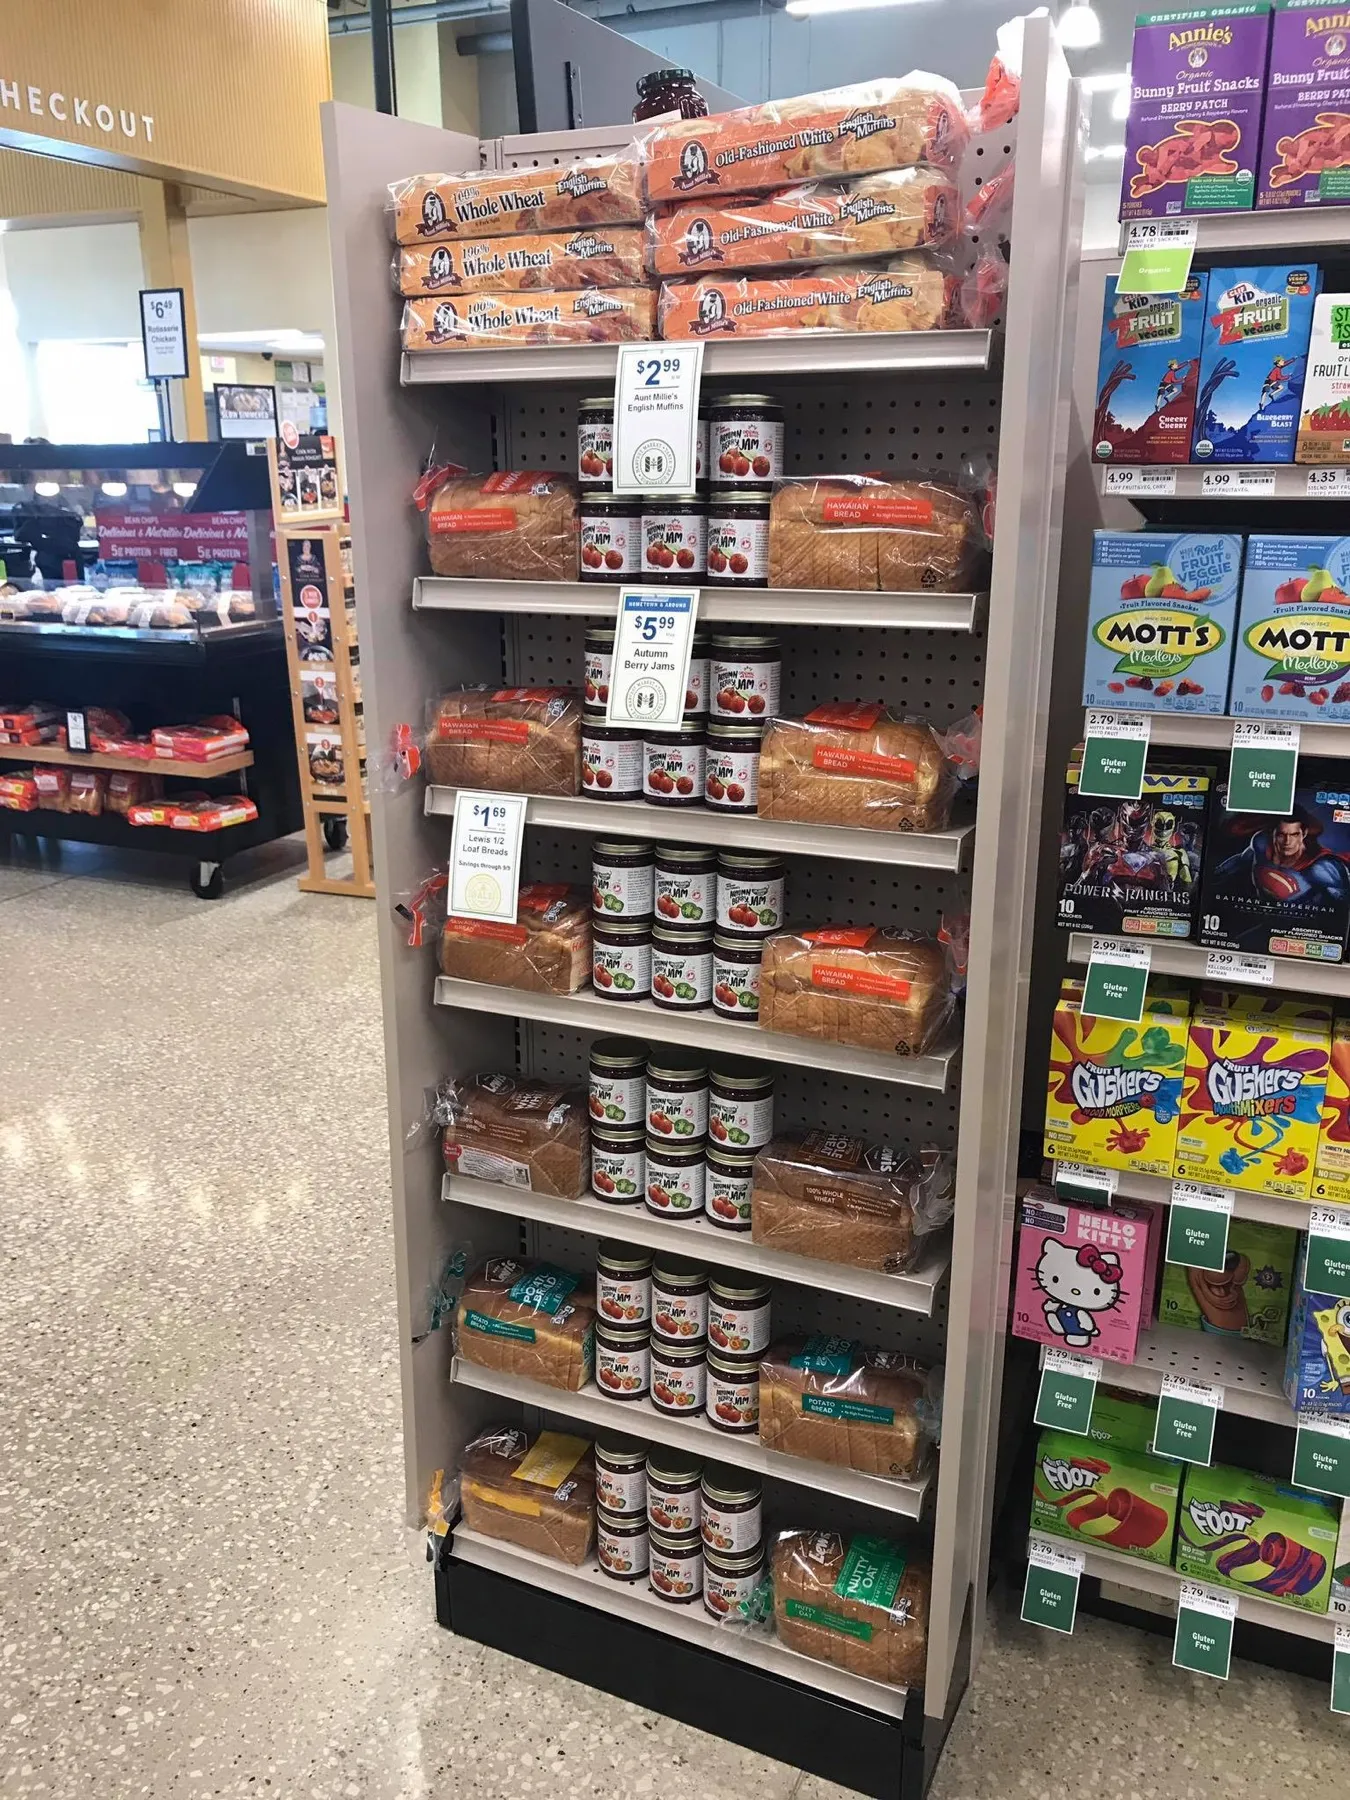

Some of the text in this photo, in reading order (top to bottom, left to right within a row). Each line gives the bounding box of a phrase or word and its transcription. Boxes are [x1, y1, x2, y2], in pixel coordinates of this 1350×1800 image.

[1150, 5, 1257, 22] CERTIFIED ORGANIC
[1168, 22, 1233, 51] Annie's
[1176, 70, 1214, 81] Organic
[1273, 67, 1350, 85] Bunny Fruit
[1134, 76, 1260, 99] Bunny Fruit Snacks
[1298, 91, 1330, 101] BERRY
[1161, 99, 1228, 113] BERRY PATCH
[838, 111, 896, 142] English Muffins
[715, 138, 796, 168] Old-Fashioned
[799, 129, 834, 147] White
[557, 173, 608, 199] English Muffins
[455, 190, 546, 224] Whole Wheat
[840, 198, 895, 224] English Muffins
[720, 213, 834, 245] Old-Fashioned White
[1130, 226, 1157, 238] 4.78
[565, 237, 614, 259] English Muffins
[463, 250, 553, 277] Whole Wheat
[1138, 266, 1171, 275] Organic
[857, 279, 912, 303] English Muffins
[733, 292, 850, 317] Old-Fashioned White
[468, 312, 513, 332] Whole
[1313, 364, 1341, 377] FRUIT
[653, 392, 678, 401] Millie's
[628, 402, 684, 412] English Muffins
[739, 438, 760, 451] JAM
[1108, 472, 1133, 483] 4.99
[1203, 474, 1230, 486] 4.99
[1308, 472, 1336, 483] 4.35
[827, 502, 869, 511] HAWAIIAN
[833, 510, 861, 518] BREAD
[99, 526, 136, 538] Delicious
[184, 526, 225, 539] Delicious
[124, 547, 152, 557] PROTEIN
[159, 547, 178, 557] FIBER
[1195, 540, 1224, 555] Real
[1181, 552, 1223, 572] FRUIT
[1177, 562, 1232, 583] VEGGIE
[1140, 600, 1171, 608] Flavored
[1296, 605, 1329, 614] Flavored
[633, 648, 669, 659] Autumn
[1129, 649, 1182, 665] Medleys
[624, 660, 675, 672] Berry Jams
[1282, 655, 1339, 672] Medleys
[588, 668, 603, 679] JAM
[1085, 693, 1095, 705] 10
[1089, 714, 1114, 725] 2.79
[1235, 724, 1261, 735] 2.79
[817, 749, 856, 762] HAWAIIAN
[823, 758, 848, 768] BREAD
[1100, 758, 1127, 767] Gluten
[1104, 766, 1122, 774] Free
[1248, 771, 1276, 781] Gluten
[1251, 779, 1271, 788] Free
[468, 834, 505, 845] Lewis 1/2
[462, 844, 508, 857] Loaf Breads
[458, 860, 480, 869] Savings
[480, 862, 503, 871] through
[671, 888, 688, 898] JAM
[1063, 883, 1191, 905] POWER RANGERS
[1058, 899, 1075, 913] 10
[1215, 894, 1261, 905] BATMAN
[1276, 901, 1335, 913] SUPERMAN
[1203, 914, 1221, 931] 10
[1202, 929, 1228, 938] POUCHES
[1093, 940, 1116, 951] 2.99
[1208, 953, 1233, 964] 2.99
[815, 968, 854, 980] HAWAIIAN
[821, 977, 847, 987] BREAD
[1103, 982, 1128, 992] Gluten
[1106, 990, 1123, 999] Free
[1085, 1061, 1113, 1075] FRUIT
[1222, 1059, 1251, 1073] FRUIT
[1072, 1064, 1163, 1109] Gushers
[1208, 1062, 1303, 1105] Gushers
[720, 1112, 735, 1123] JAM
[1047, 1143, 1056, 1155] 6
[1058, 1160, 1080, 1172] 2.79
[806, 1186, 845, 1198] 100% WHOLE
[1174, 1182, 1198, 1193] 2.79
[813, 1195, 836, 1204] WHEAT
[1311, 1211, 1336, 1223] 2.79
[1078, 1213, 1136, 1238] HELLO
[1077, 1226, 1137, 1250] KITTY
[1185, 1228, 1210, 1240] Gluten
[1188, 1236, 1205, 1246] Free
[1327, 1267, 1346, 1277] Free
[1016, 1311, 1030, 1323] 10
[721, 1320, 736, 1331] JAM
[1046, 1348, 1068, 1359] 2.79
[1163, 1373, 1186, 1385] 2.79
[1054, 1391, 1078, 1404] Gluten
[1302, 1388, 1316, 1399] 10
[808, 1398, 836, 1408] POTATO
[1056, 1399, 1073, 1410] Free
[1173, 1419, 1197, 1432] Gluten
[1176, 1428, 1193, 1439] Free
[1312, 1452, 1338, 1465] Gluten
[1315, 1461, 1333, 1472] Free
[1042, 1461, 1100, 1492] FOOT
[707, 1519, 720, 1531] JAM
[1033, 1517, 1041, 1526] 6
[1189, 1506, 1253, 1536] FOOT
[1032, 1542, 1052, 1554] 2.79
[846, 1556, 870, 1594] NUTTY
[1039, 1588, 1062, 1601] Gluten
[1181, 1585, 1204, 1597] 2.79
[1042, 1597, 1057, 1607] Free
[1333, 1601, 1346, 1612] 10
[1192, 1631, 1216, 1645] Gluten
[1195, 1641, 1211, 1651] Free
